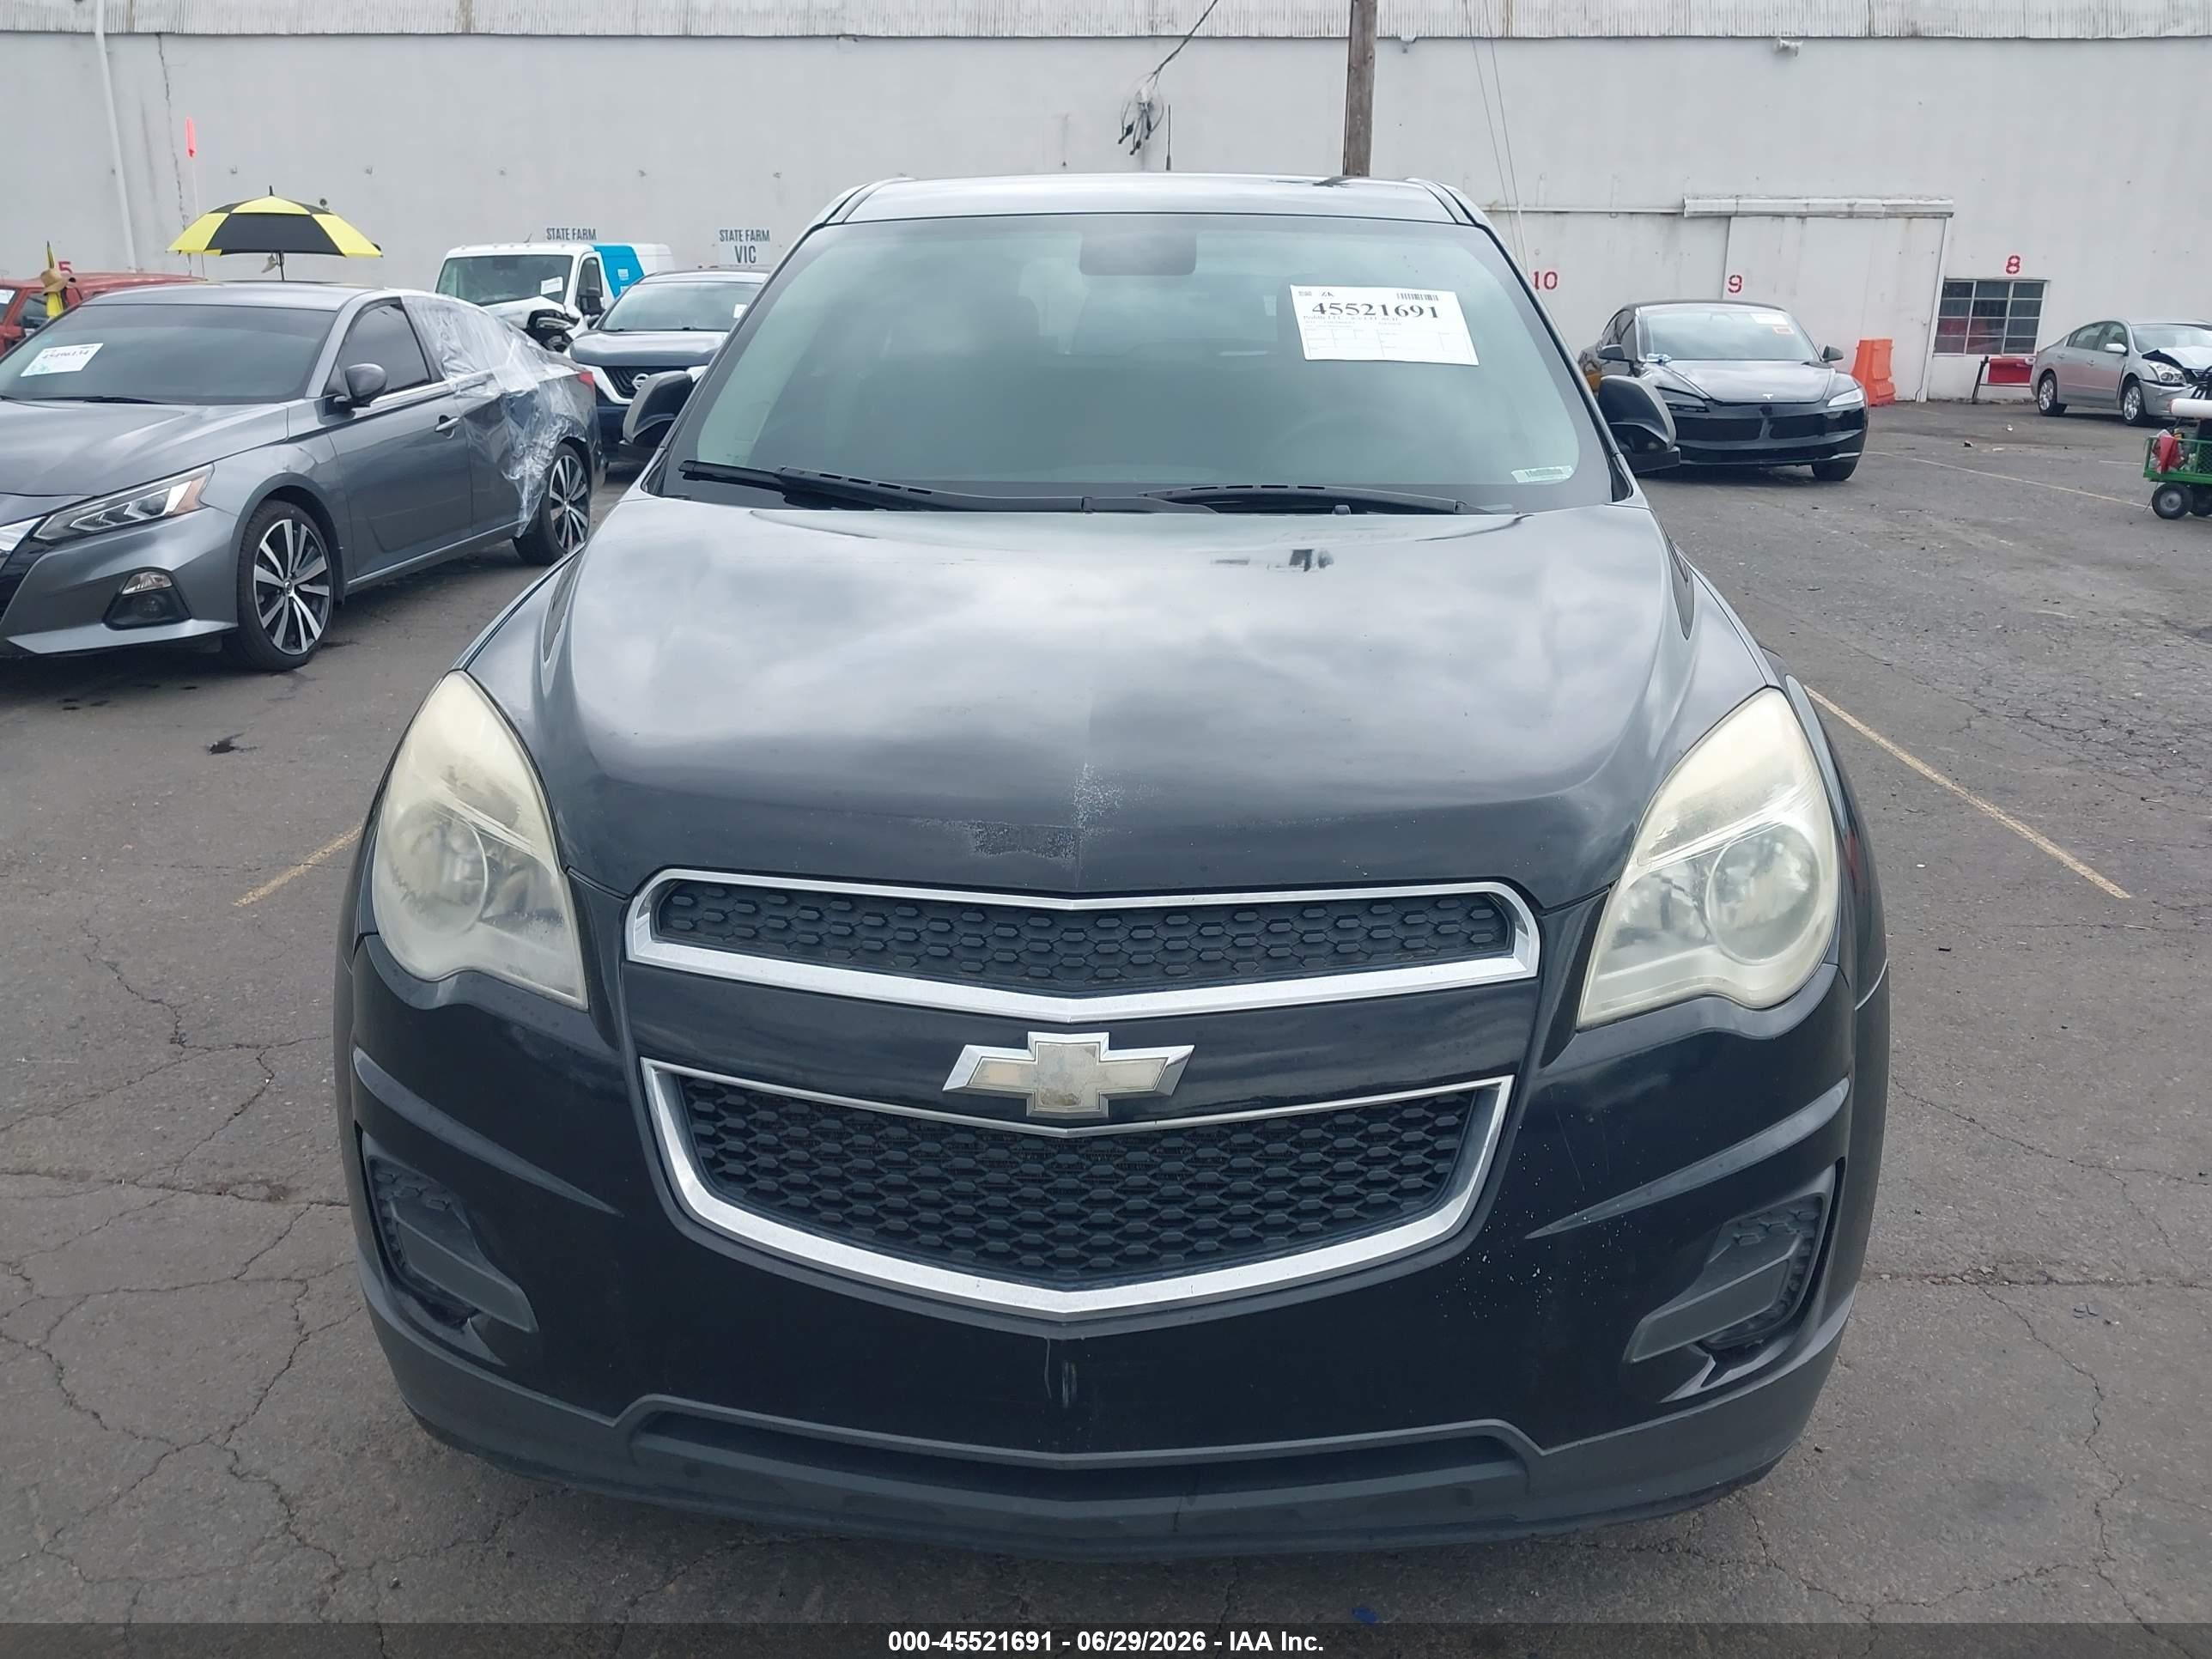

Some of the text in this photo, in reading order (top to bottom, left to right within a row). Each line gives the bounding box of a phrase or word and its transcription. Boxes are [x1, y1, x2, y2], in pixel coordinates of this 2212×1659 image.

[546, 228, 598, 241] STATE FARM
[719, 228, 770, 242] STATE FARM
[734, 245, 757, 264] VIC
[58, 260, 73, 274] 5
[2004, 253, 2021, 276] 8
[1533, 270, 1559, 290] 10
[1728, 275, 1744, 295] 9
[1311, 302, 1439, 319] 45521691
